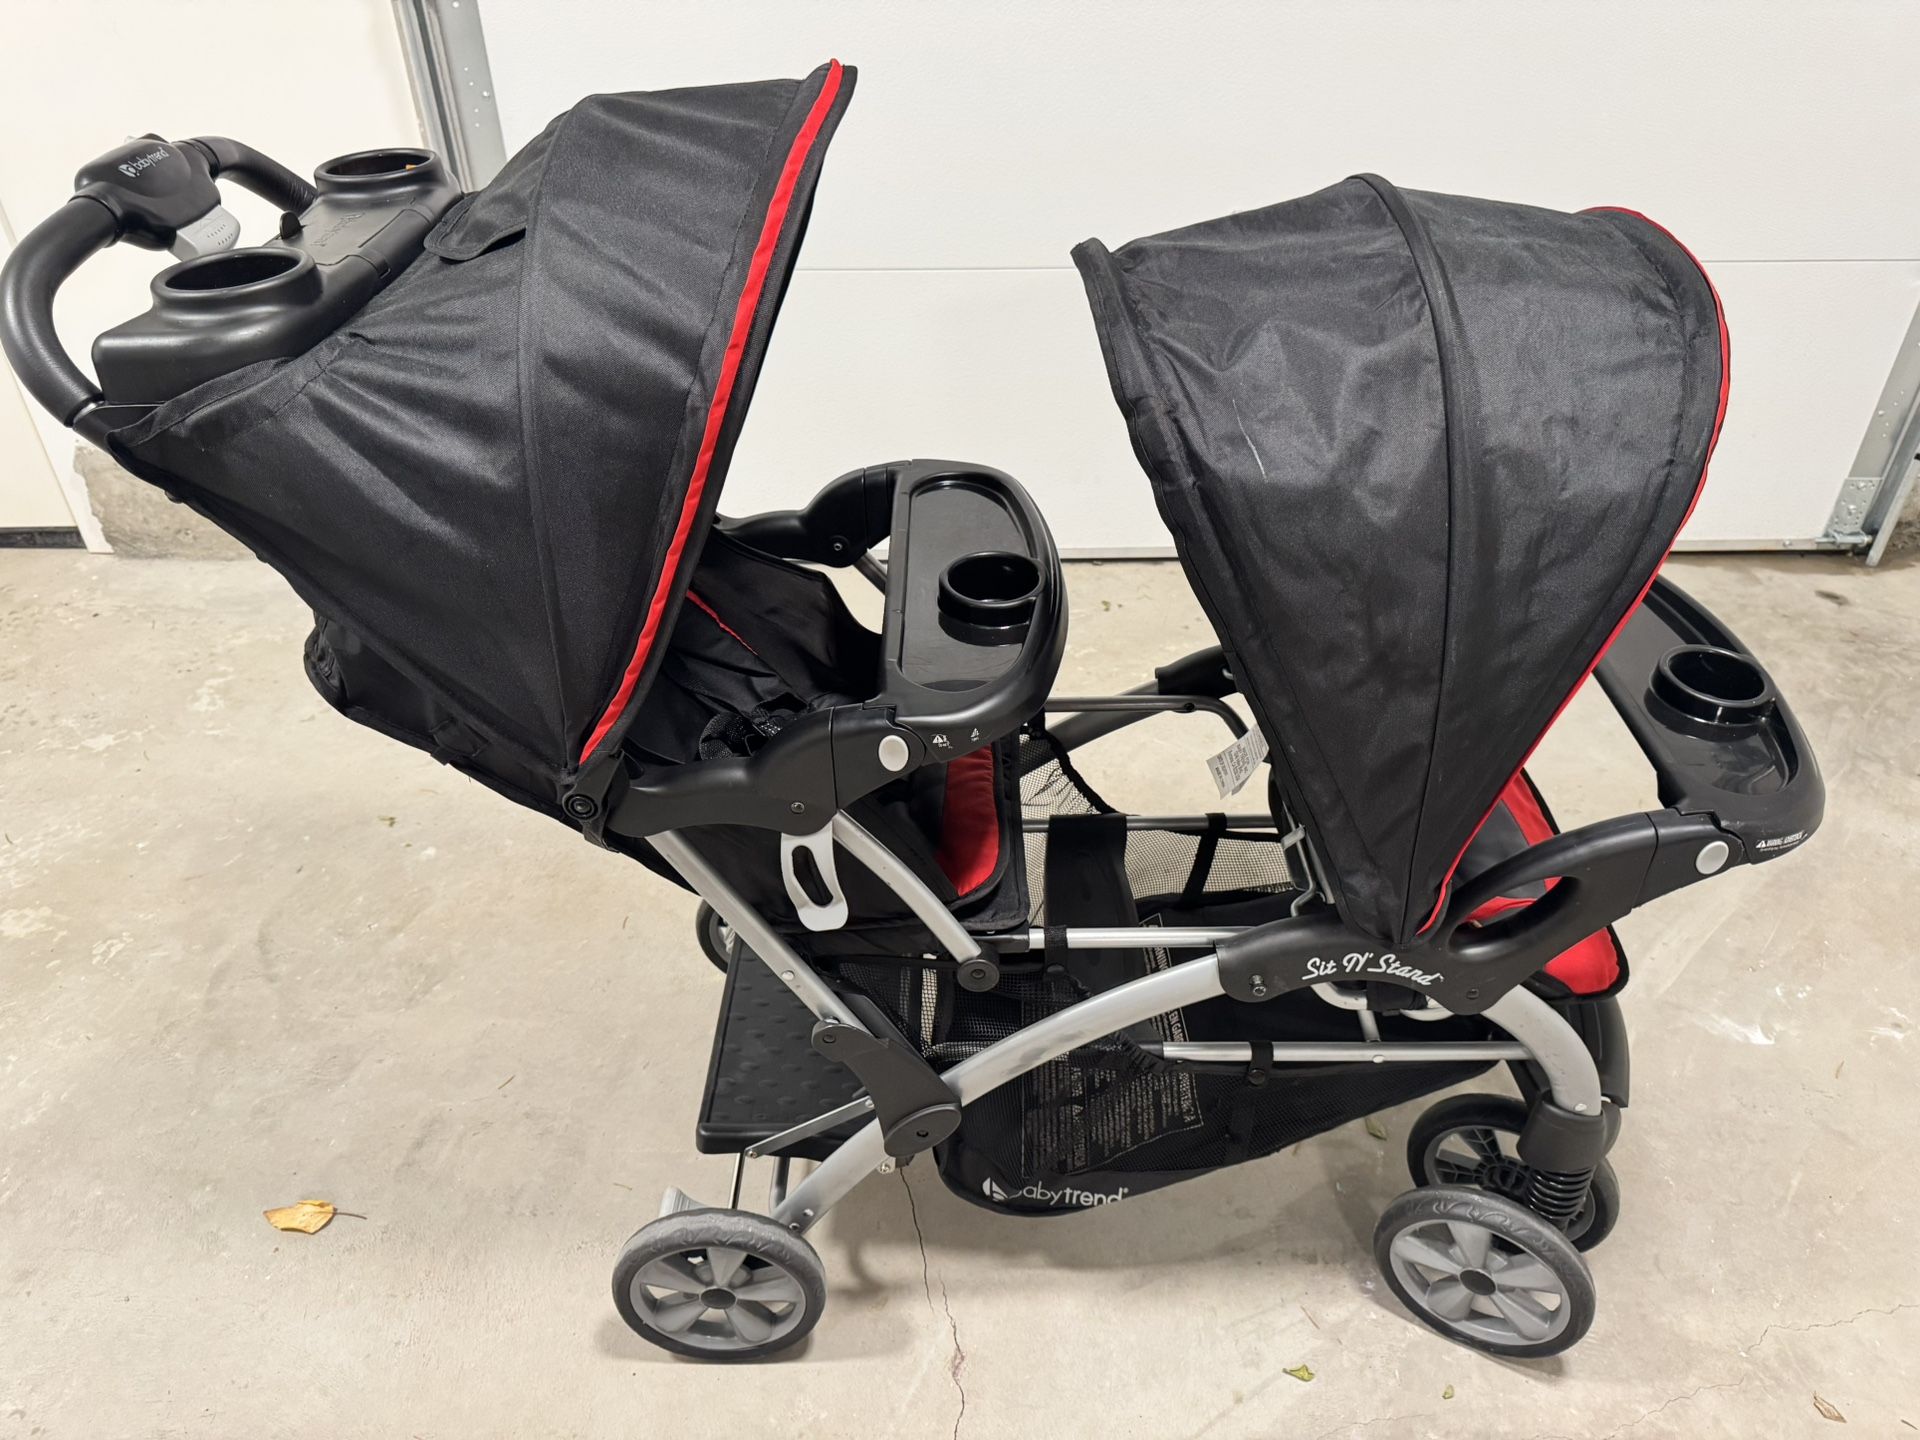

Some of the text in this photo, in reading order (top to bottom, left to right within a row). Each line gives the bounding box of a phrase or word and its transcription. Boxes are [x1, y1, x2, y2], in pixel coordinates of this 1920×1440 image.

[128, 146, 169, 171] babytrend
[1302, 957, 1337, 980] Sit
[1367, 953, 1440, 986] Stand
